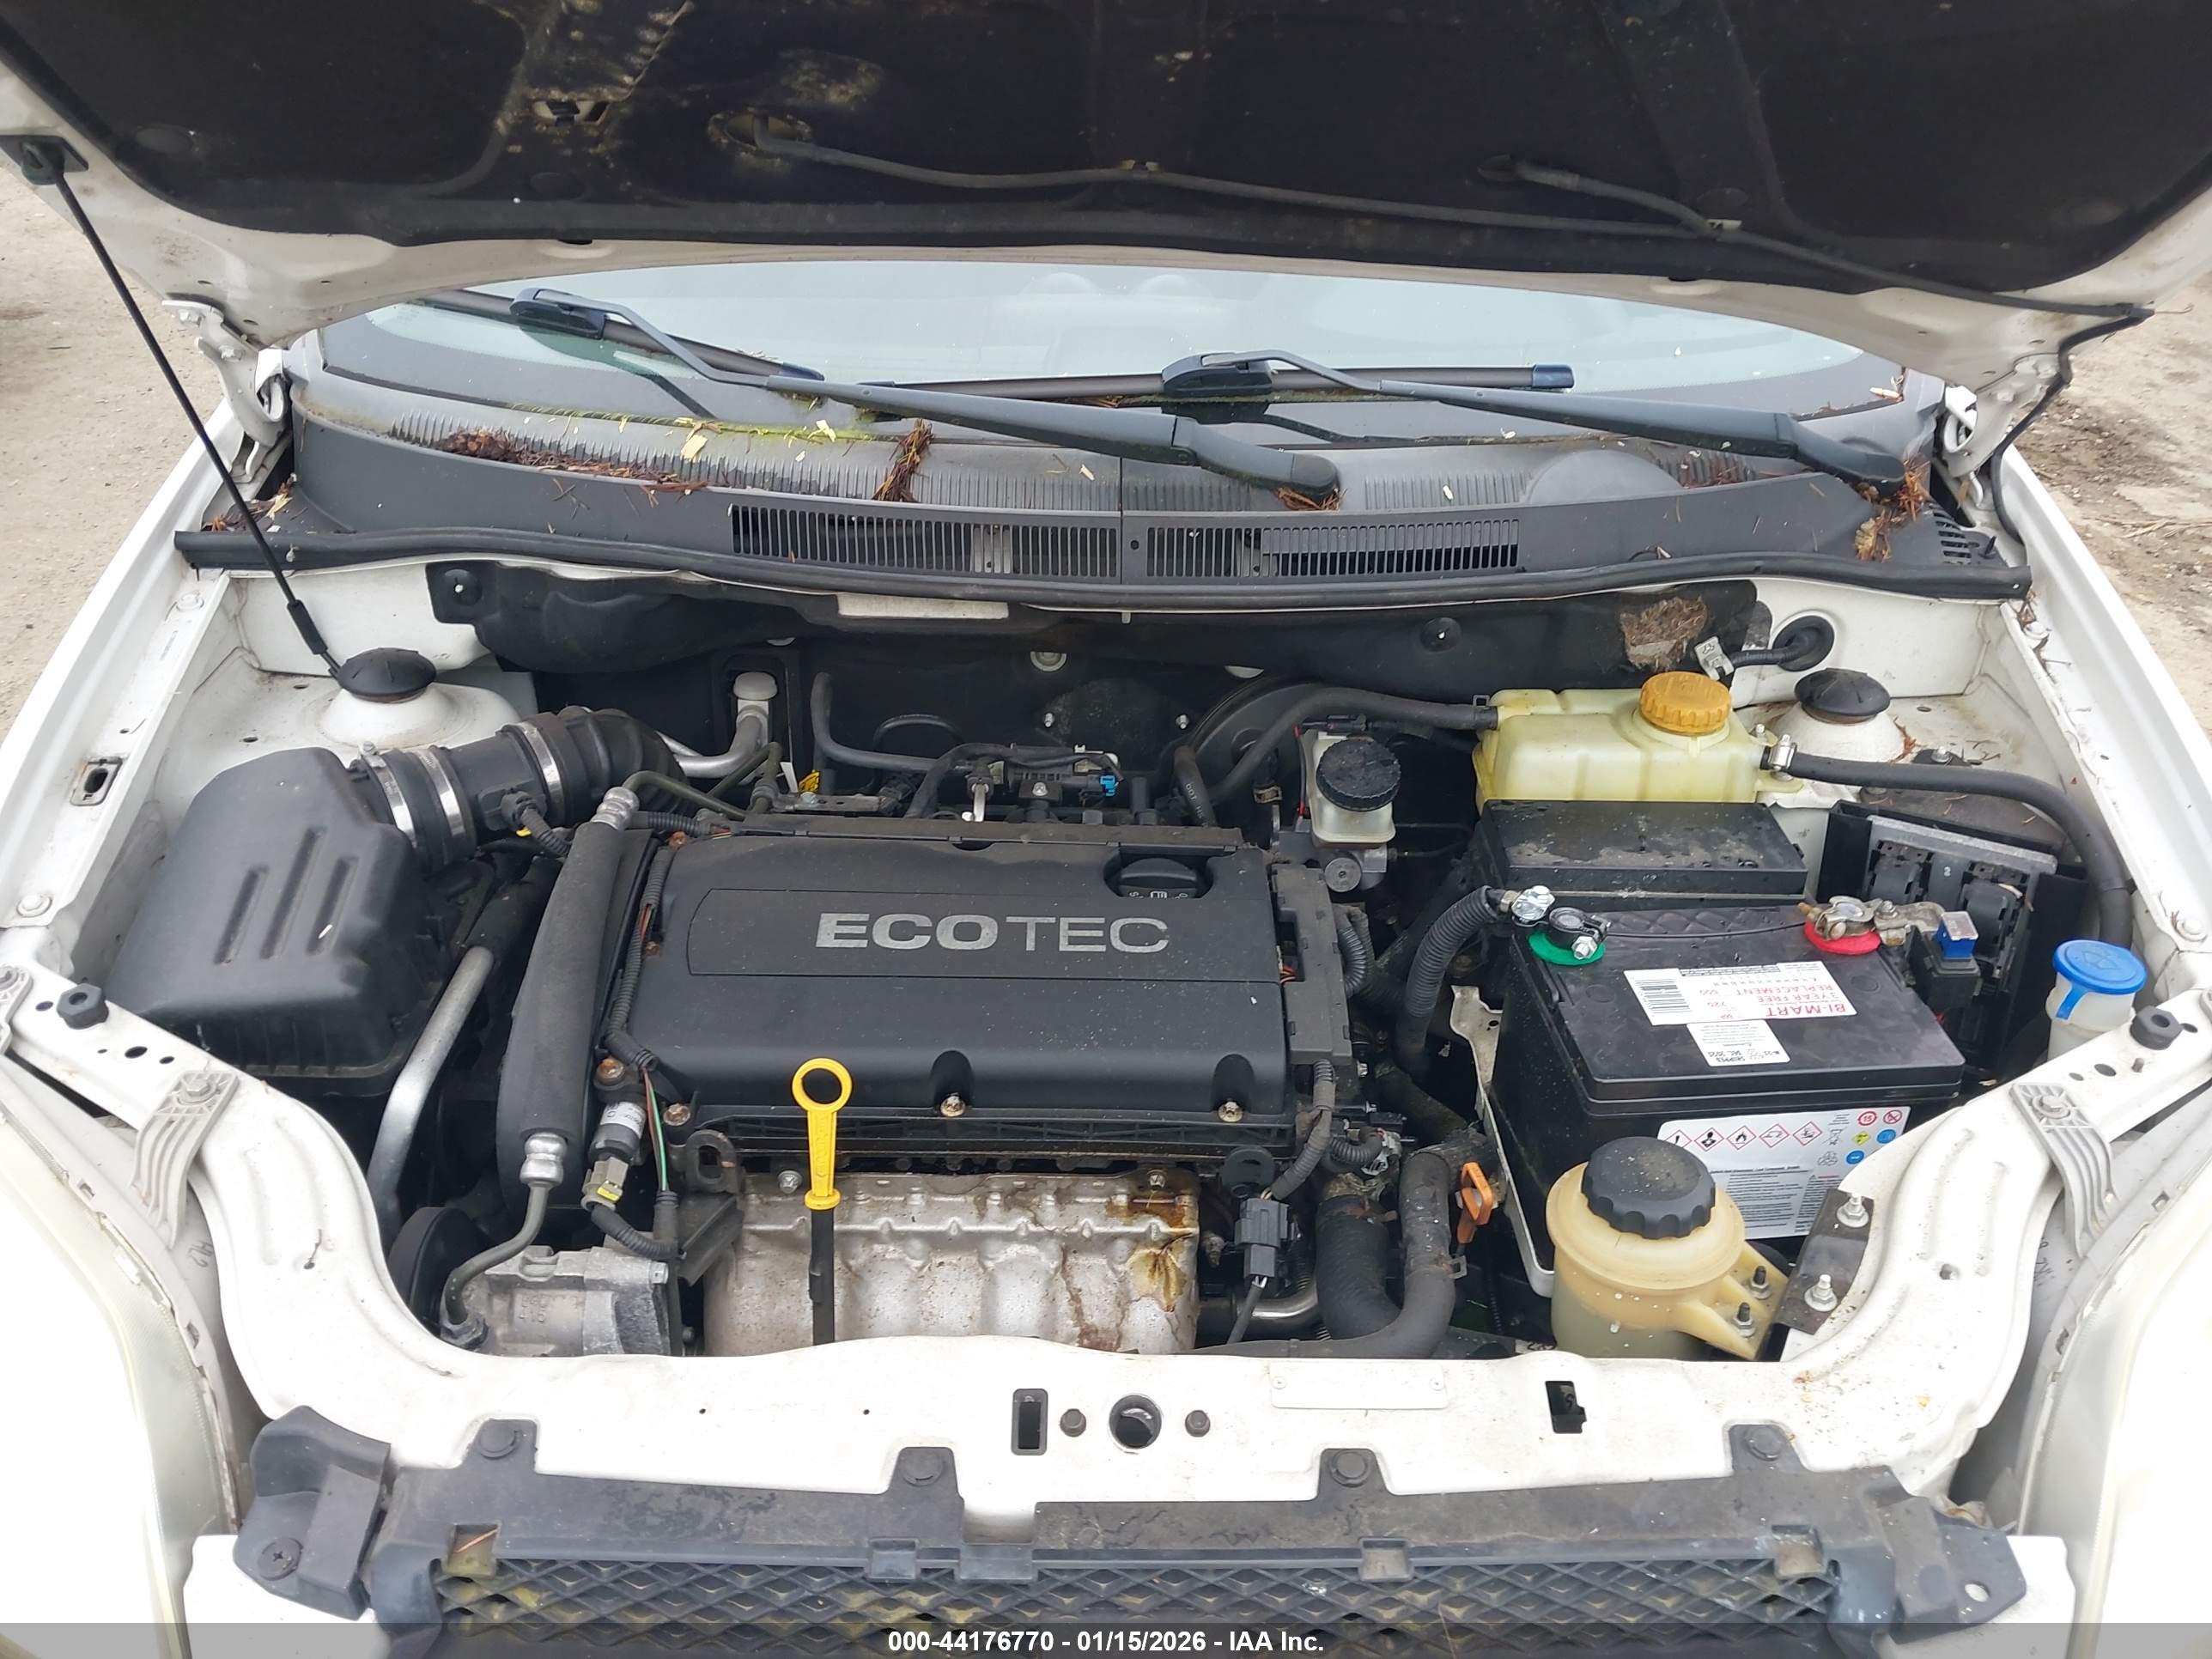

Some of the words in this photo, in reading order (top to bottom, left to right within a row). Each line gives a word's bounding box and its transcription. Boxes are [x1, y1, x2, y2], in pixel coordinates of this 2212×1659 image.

[1943, 866, 1952, 877] 2
[815, 912, 1170, 953] ECOTEC
[1735, 985, 1833, 995] REPLACEMENT
[1793, 993, 1827, 1001] YEAR
[1765, 1003, 1846, 1017] BI-MART
